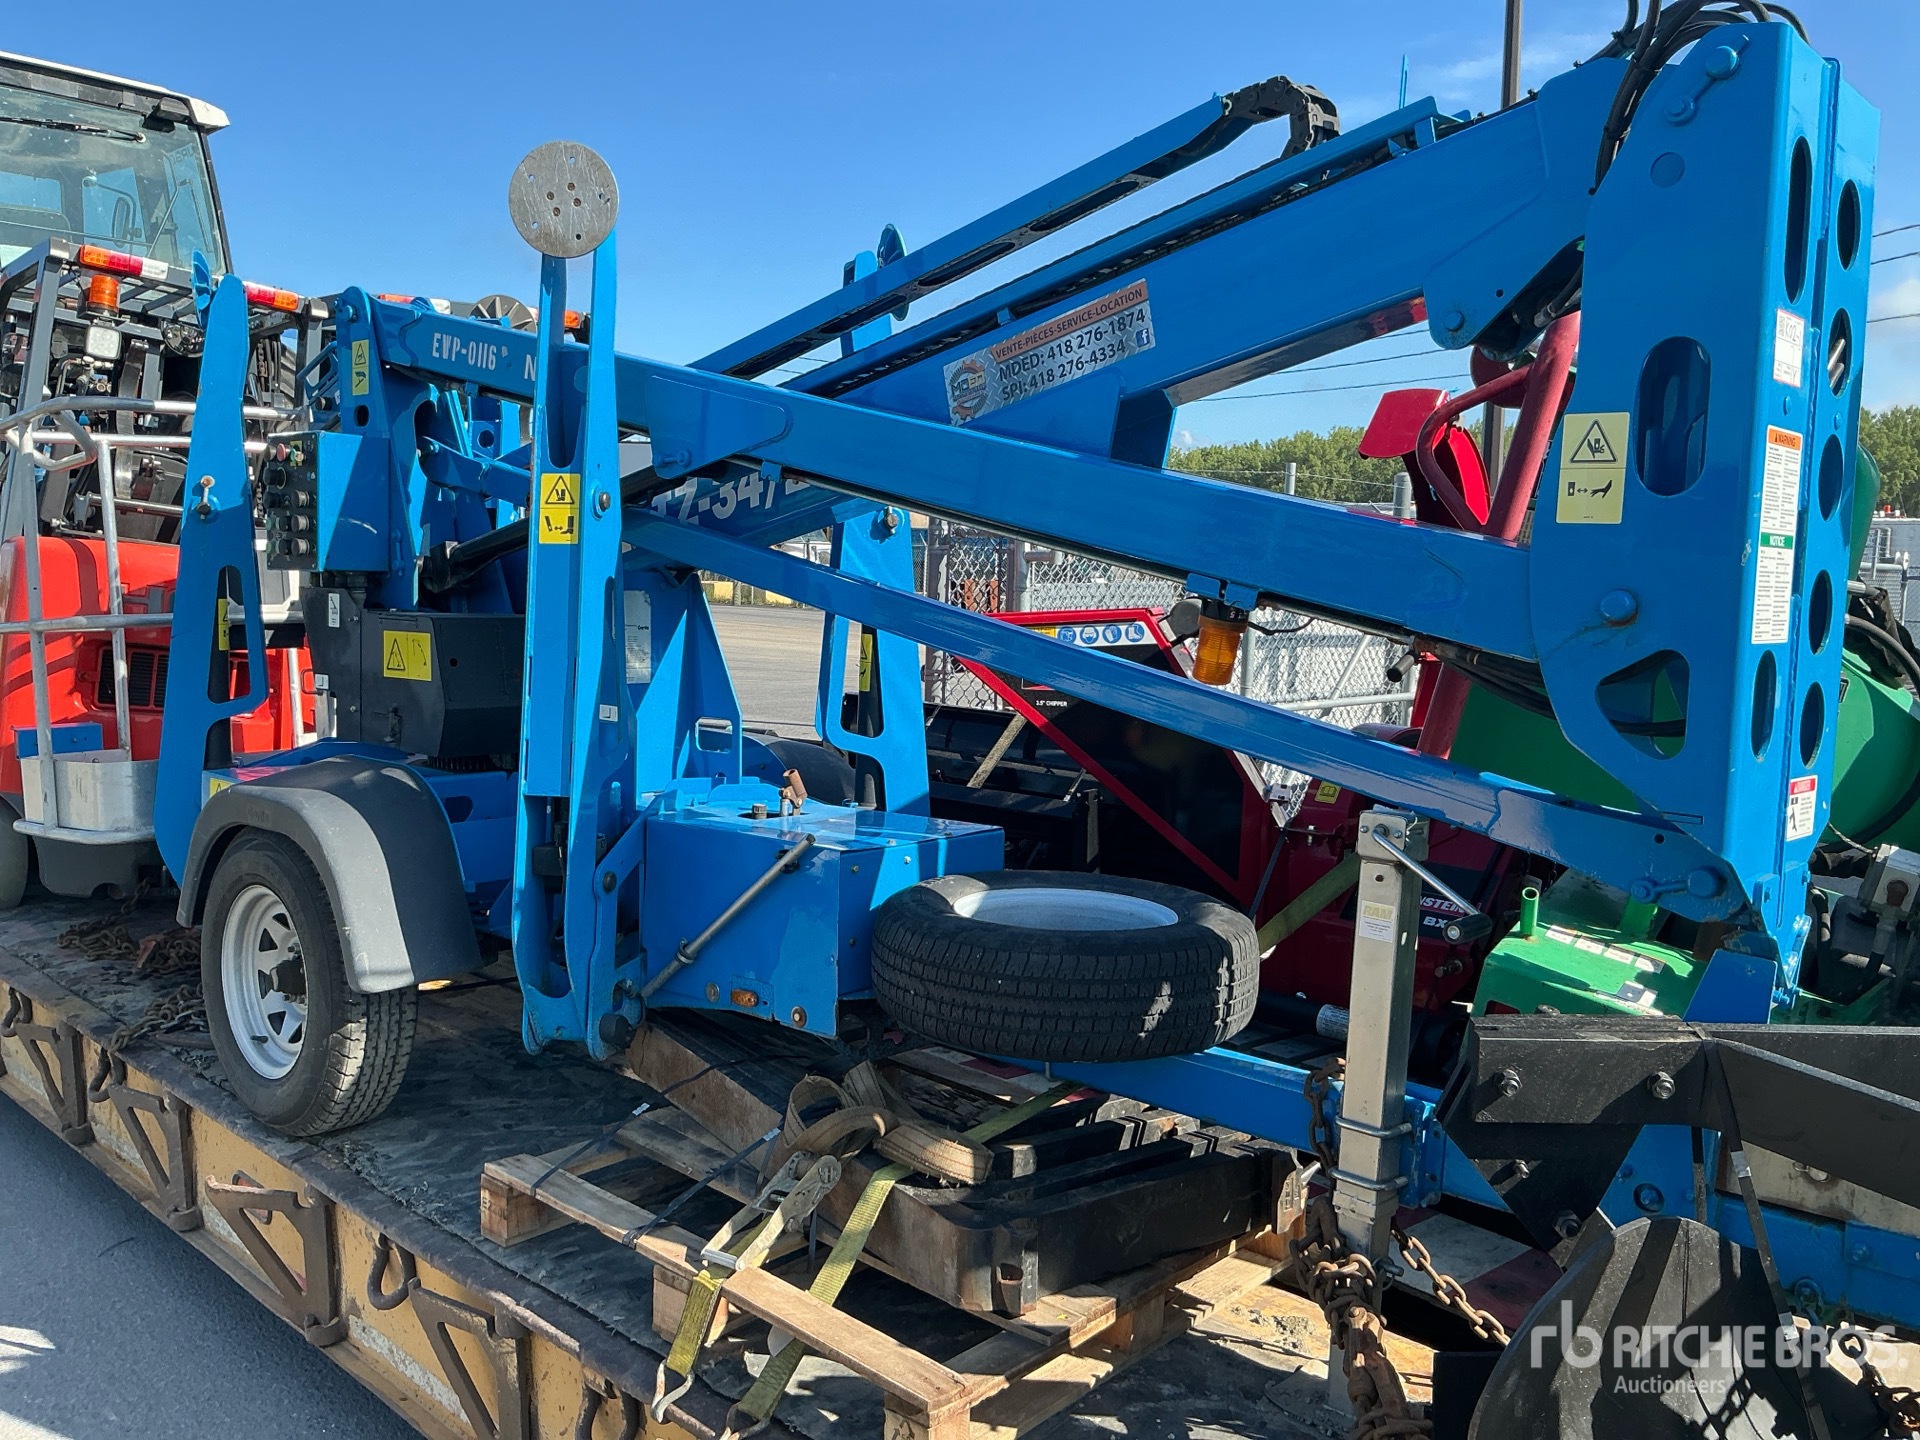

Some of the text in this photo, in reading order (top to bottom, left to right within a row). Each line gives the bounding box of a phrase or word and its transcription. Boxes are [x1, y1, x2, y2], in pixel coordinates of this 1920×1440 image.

[995, 288, 1143, 359] VENTE-PIÈCES-SERVICE-LOCATION
[999, 308, 1146, 382] MDED: 418 276-1874
[1002, 381, 1028, 401] SPI:
[1029, 369, 1055, 390] 418
[1058, 339, 1126, 379] 276-4334
[1769, 535, 1785, 547] NOTICE
